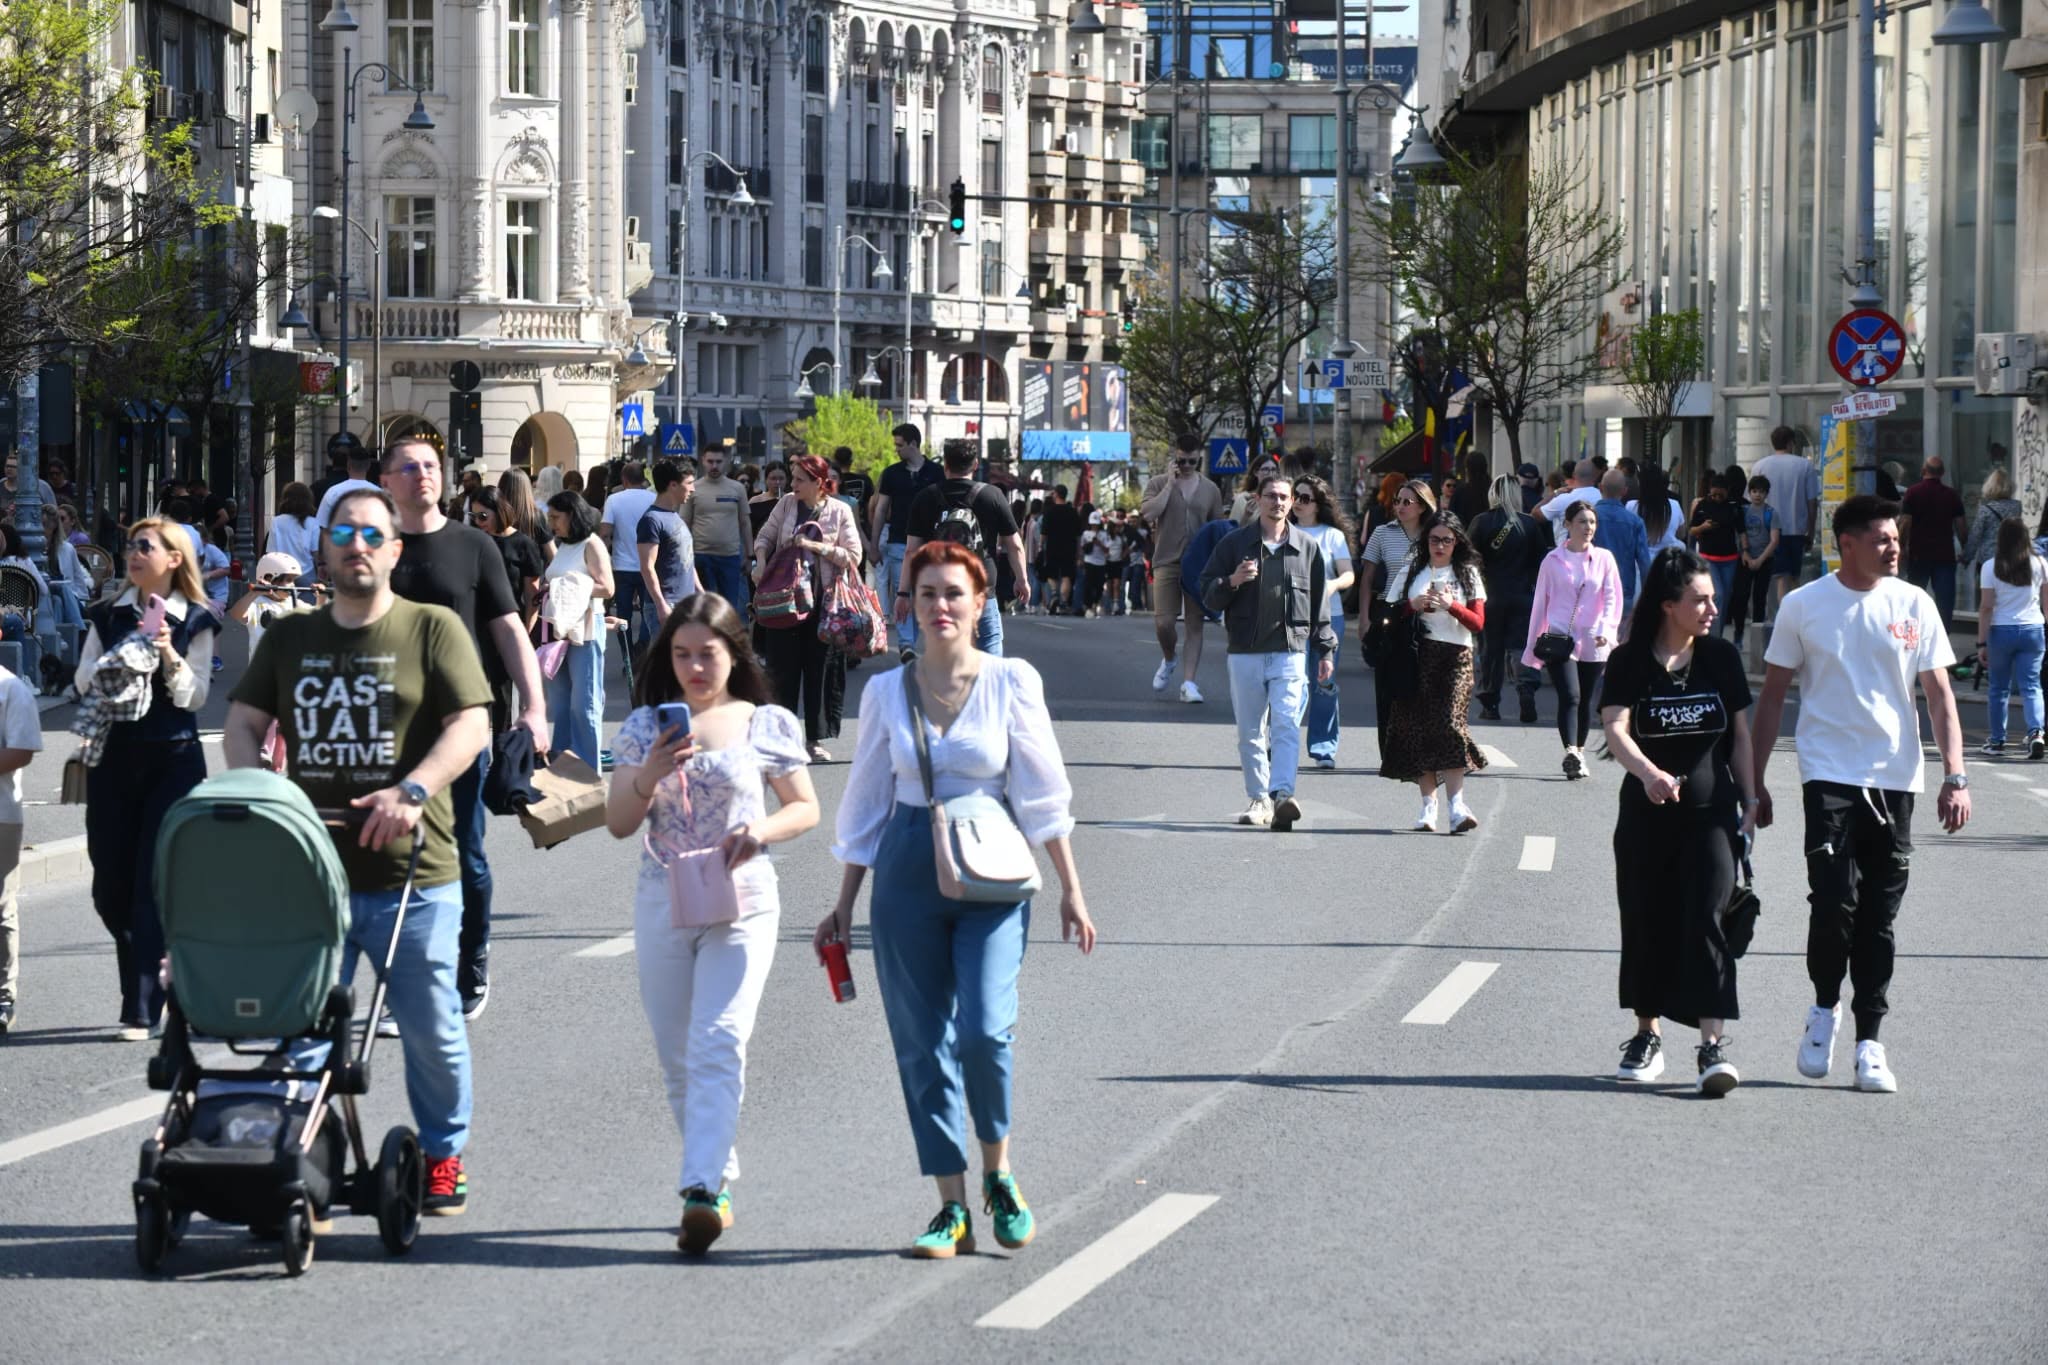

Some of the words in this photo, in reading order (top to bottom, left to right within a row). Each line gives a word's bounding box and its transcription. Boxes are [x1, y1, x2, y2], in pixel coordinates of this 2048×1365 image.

[391, 360, 450, 378] GRAN
[481, 361, 546, 379] HOTEL
[1353, 361, 1383, 373] HOTEL
[293, 705, 395, 740] UAL
[1661, 712, 1704, 728] MUSE
[296, 740, 396, 767] ACTIVE
